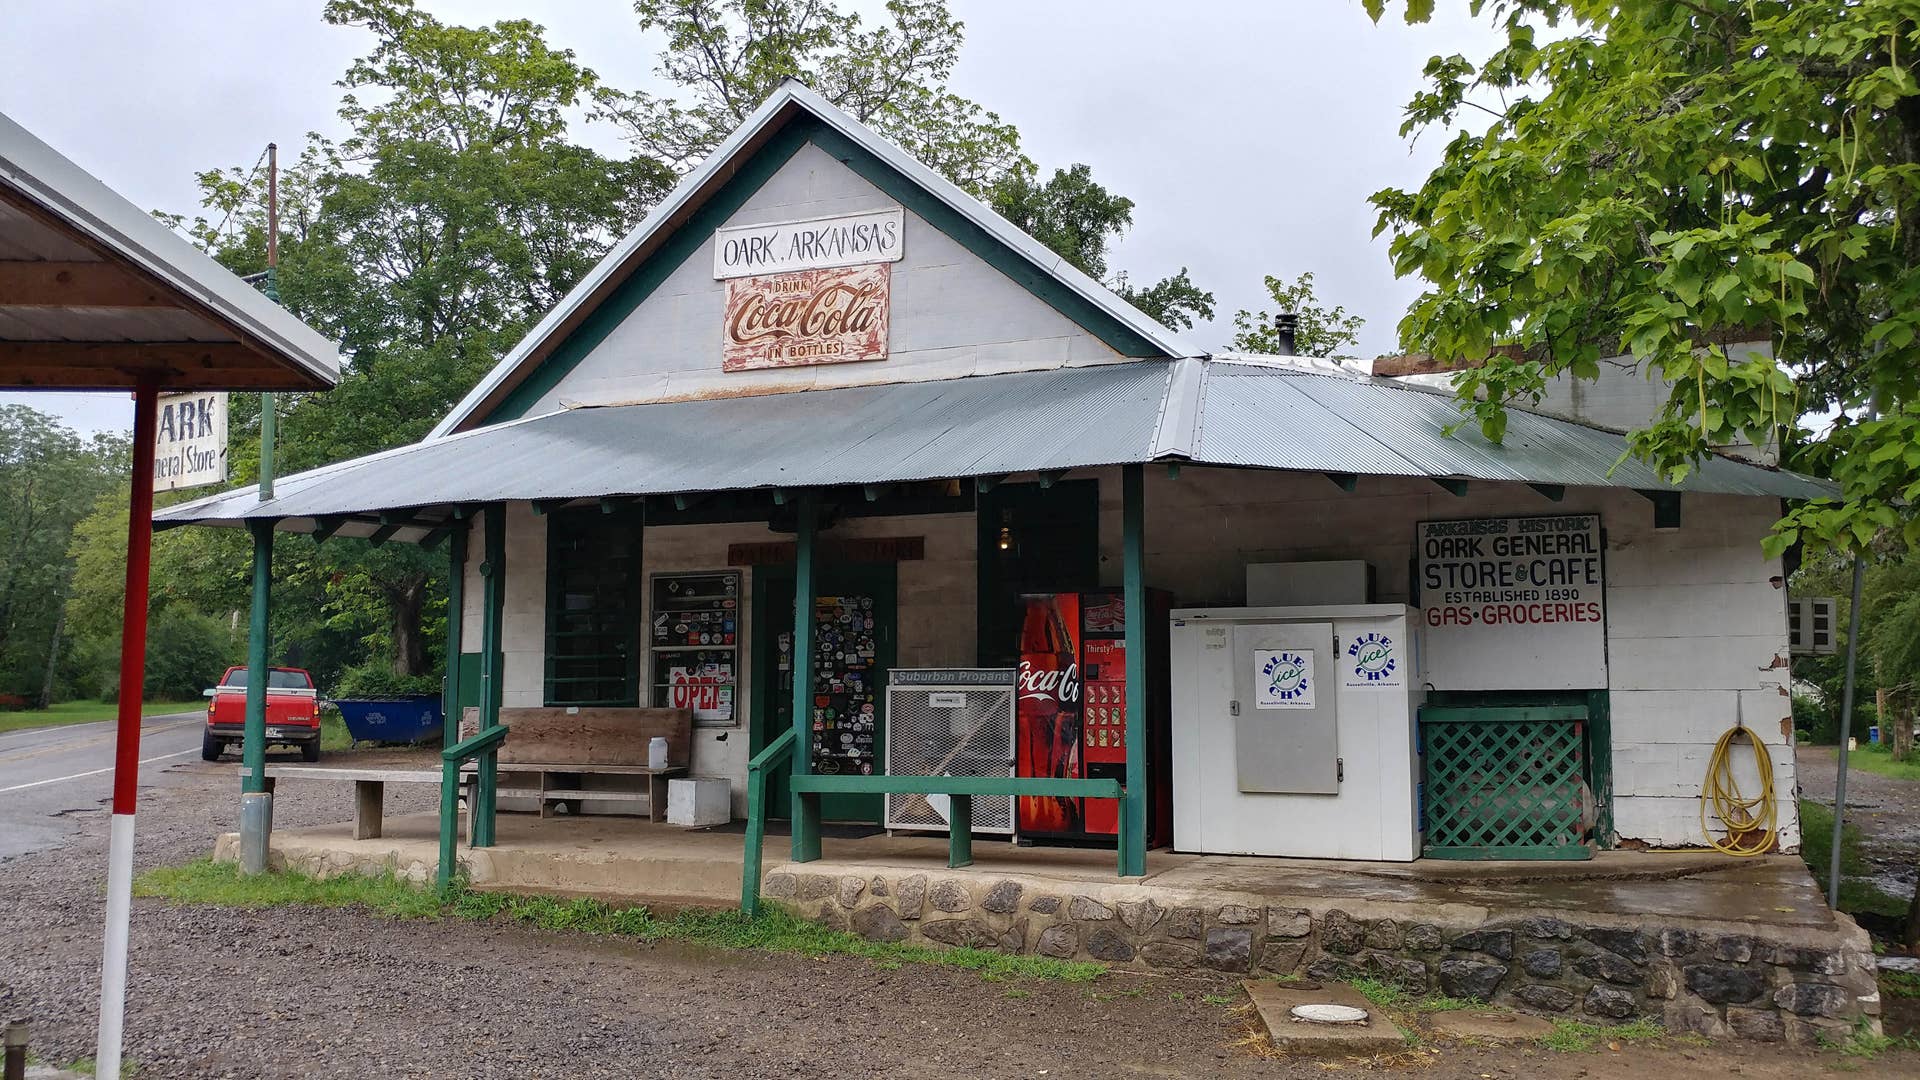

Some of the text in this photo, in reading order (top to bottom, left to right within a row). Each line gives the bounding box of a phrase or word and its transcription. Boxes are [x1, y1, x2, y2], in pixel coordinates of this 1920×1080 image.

[788, 221, 896, 261] ARKANSAS
[775, 281, 808, 292] DRINK
[768, 343, 840, 359] IN BOTTLES
[186, 445, 216, 474] Store
[1519, 517, 1592, 533] HISTORIC
[1425, 533, 1597, 559] OARK GENERAL
[1425, 558, 1598, 589] STORE & CAFE
[1445, 589, 1579, 604] ESTABLISHED 1890
[1427, 602, 1601, 626] GAS GROCERIES
[1087, 644, 1115, 655] Thirsty?
[1348, 633, 1392, 656] BLUE
[1263, 653, 1304, 676] BLUE
[1357, 648, 1392, 667] ice
[899, 671, 1009, 683] Suburban Propane
[1270, 668, 1305, 685] ice
[1355, 658, 1396, 681] CHIP
[1269, 678, 1307, 700] CHIP
